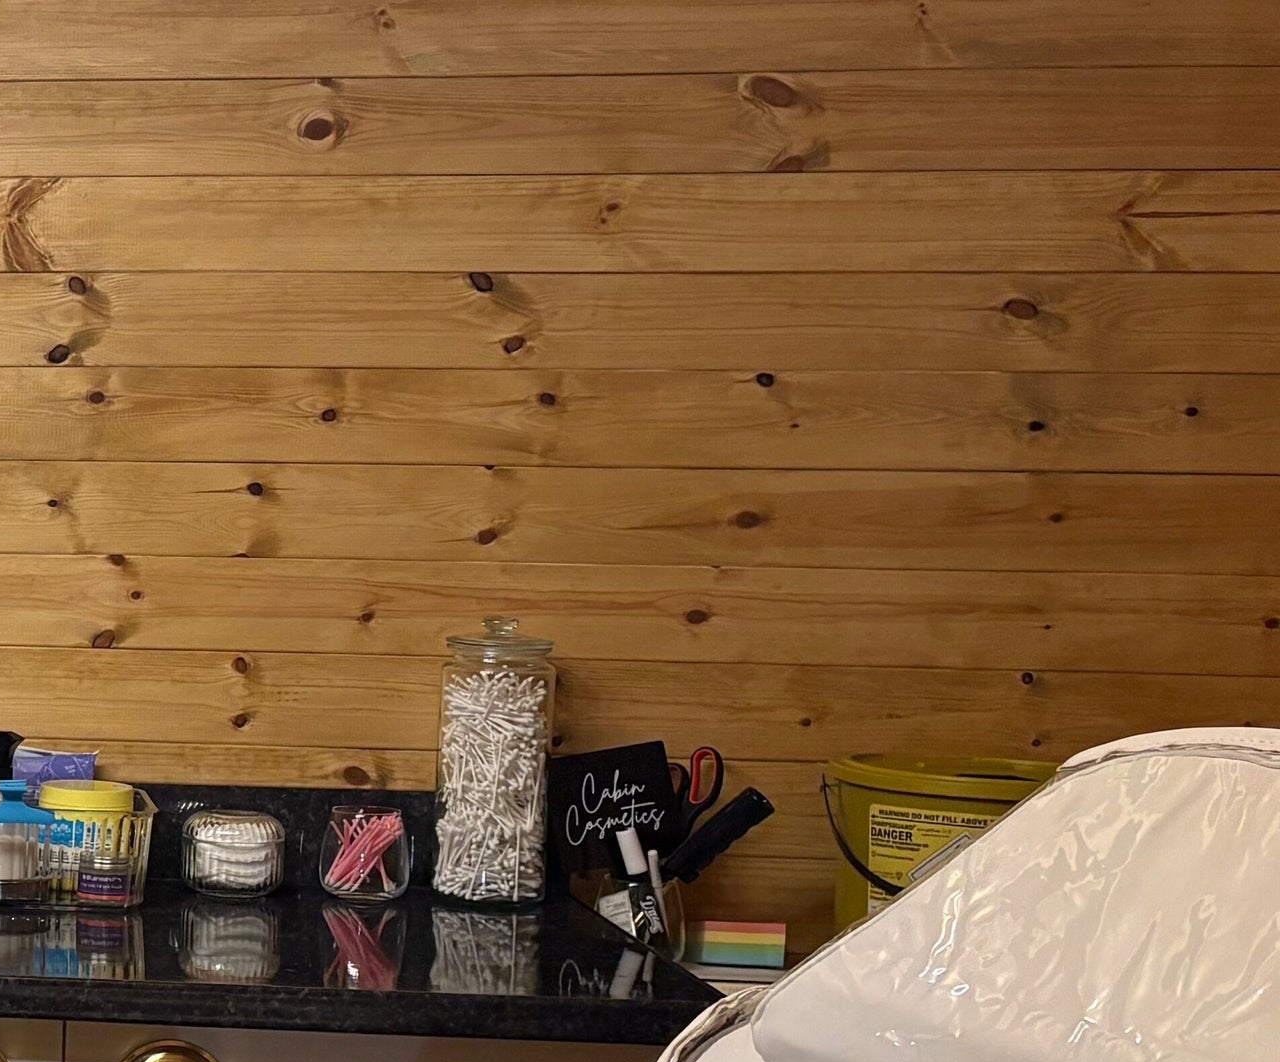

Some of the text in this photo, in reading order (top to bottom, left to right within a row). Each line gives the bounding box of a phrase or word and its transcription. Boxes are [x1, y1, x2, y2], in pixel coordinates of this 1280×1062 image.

[582, 769, 646, 814] Cabin
[565, 798, 666, 846] Cosmetics
[870, 826, 913, 841] DANGER
[911, 812, 923, 820] DO
[923, 814, 940, 822] NOT
[941, 815, 958, 824] FILL
[960, 817, 988, 827] ABOVE
